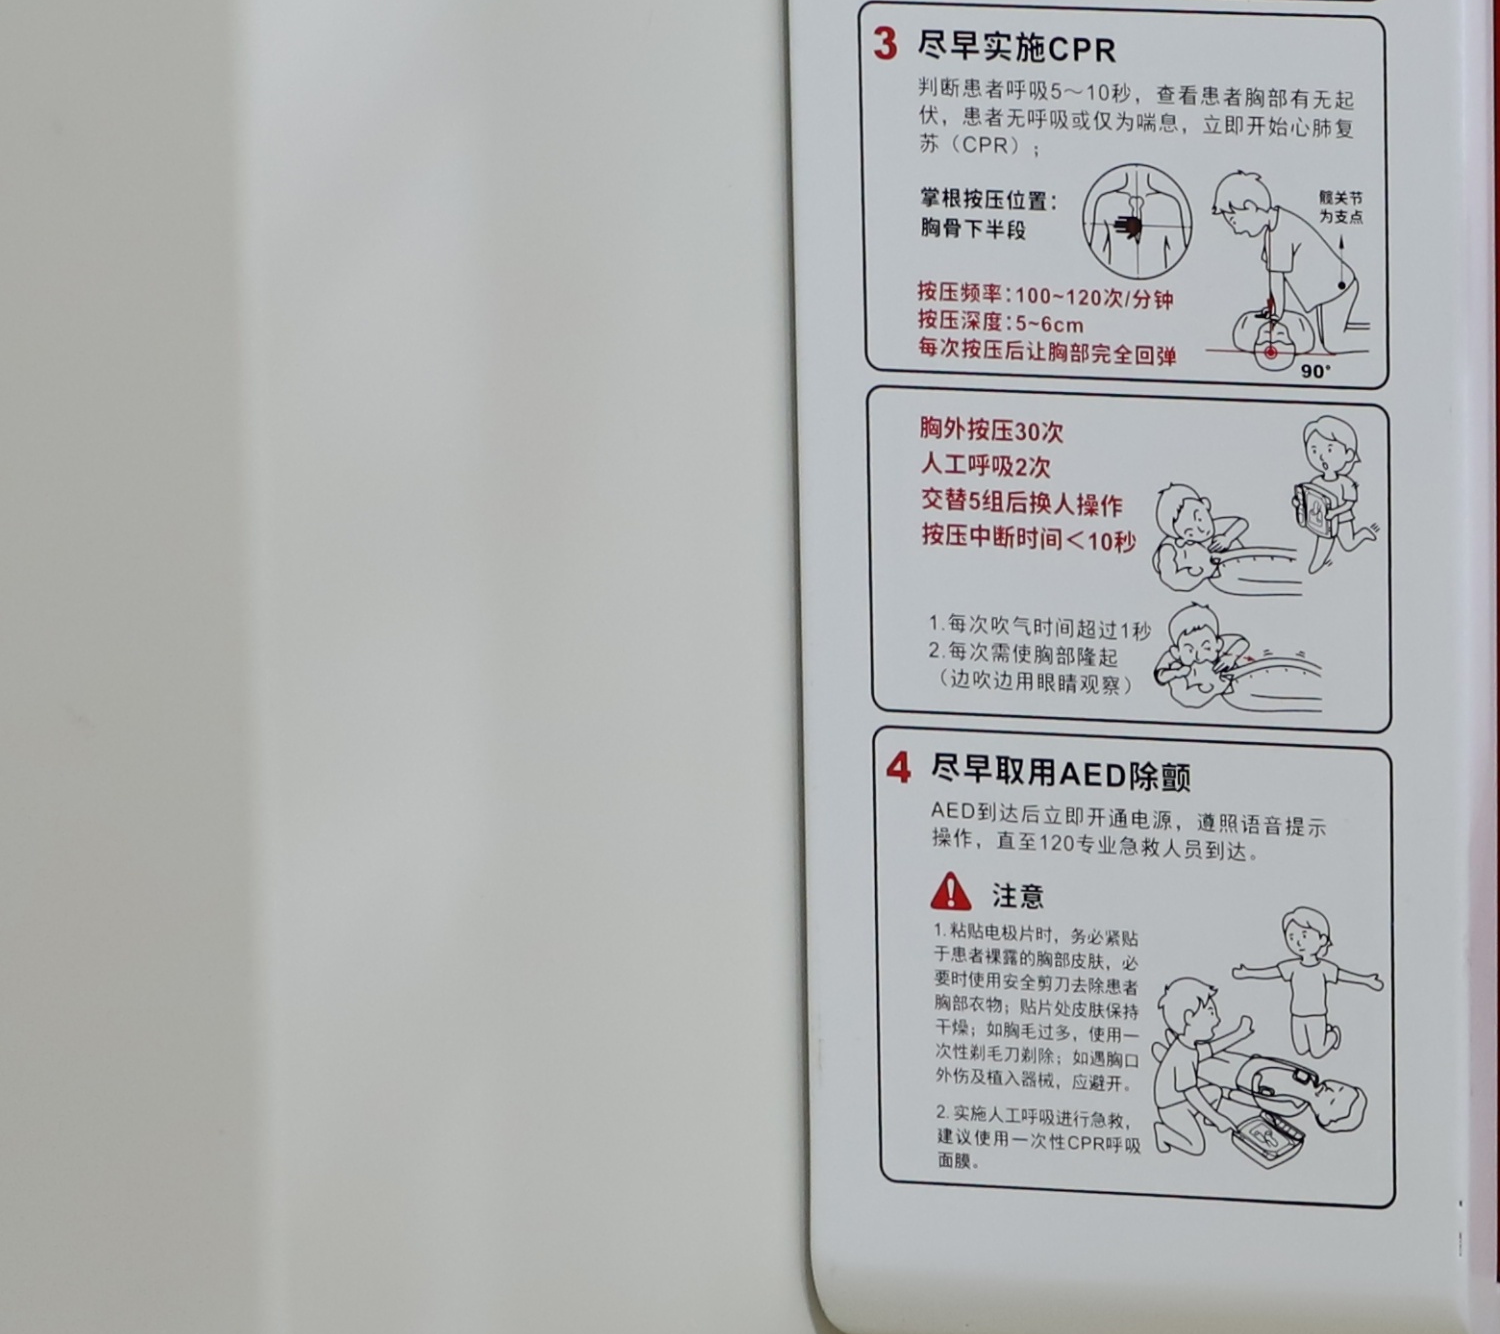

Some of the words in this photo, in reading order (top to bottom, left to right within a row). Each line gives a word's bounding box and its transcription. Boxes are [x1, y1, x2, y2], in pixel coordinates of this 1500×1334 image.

[874, 26, 897, 60] 3
[918, 30, 1116, 63] 尽早实施CPR
[919, 105, 1353, 139] 伏，患者无呼吸或仅为喘息，立即开始心肺复
[1319, 190, 1362, 205] 髋关节
[922, 217, 1025, 240] 胸骨下半段
[1320, 209, 1363, 224] 为支点
[919, 336, 1176, 366] 每次按压后让胸部完全回弹
[921, 416, 1063, 443] 胸外按压30次
[922, 451, 1050, 478] 人工呼吸2次
[922, 487, 1122, 518] 交替5组后换人操作
[930, 613, 1151, 641] 1.每次吹气时间超过1秒
[929, 641, 1117, 667] 2.每次需使胸部隆起
[941, 669, 1131, 695] （边吹边用眼睛观察）
[886, 751, 911, 783] 4
[932, 753, 1190, 792] 尽早取用AED除颤
[931, 801, 1325, 838] AED到达后立即开通电源，遵照语音提示
[932, 827, 1255, 861] 操作，直至120专业急救人员到达。
[993, 883, 1043, 909] 注意
[934, 946, 1138, 971] 于患者裸露的胸部皮肤，必
[935, 970, 1137, 996] 要时使用安全剪刀去除患者
[935, 994, 1138, 1020] 胸部衣物；贴片处皮肤保持
[936, 1019, 1139, 1043] 干燥；如胸毛过多，使用一
[936, 1043, 1138, 1068] 次性剃毛刀剃除；如遇胸口
[936, 1067, 1129, 1092] 外伤及植入器械，应避开。
[938, 1128, 1140, 1154] 建议使用一次性CPR呼吸
[938, 1152, 977, 1169] 面膜。
